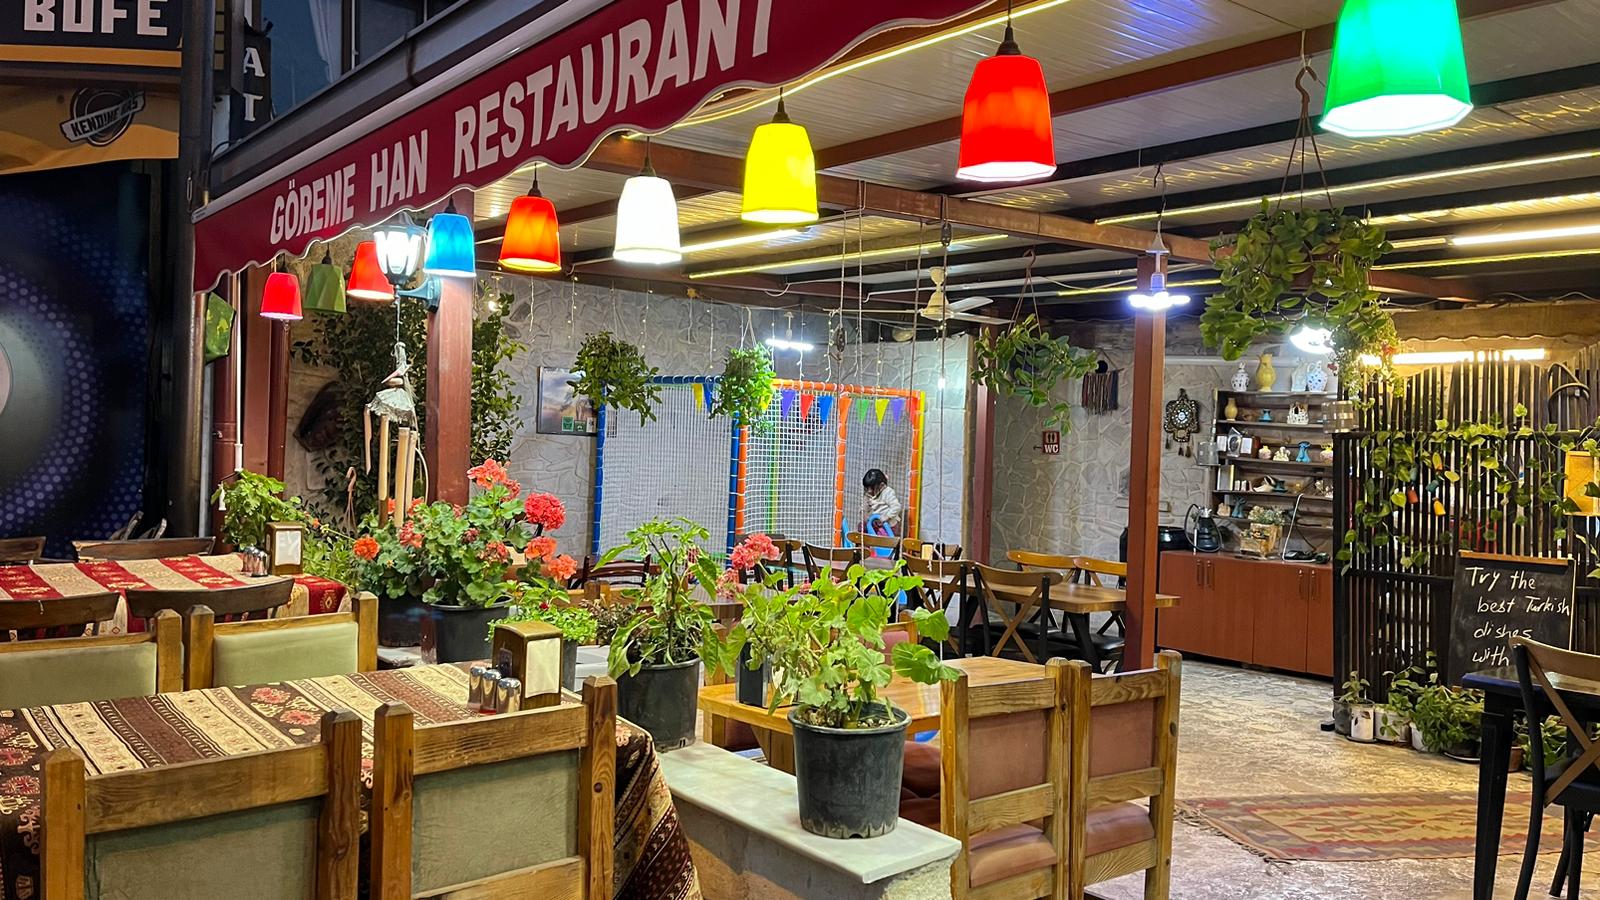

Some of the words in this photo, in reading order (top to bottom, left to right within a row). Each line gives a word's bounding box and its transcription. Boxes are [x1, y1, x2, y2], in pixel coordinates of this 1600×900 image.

[270, 163, 356, 245] GÖREME
[370, 129, 429, 213] HAN
[1044, 444, 1059, 453] WC
[1465, 566, 1501, 592] Try
[1510, 570, 1536, 590] the
[1477, 596, 1516, 613] best
[1525, 595, 1570, 616] Turkish
[1473, 621, 1533, 639] dishes
[1472, 646, 1510, 666] with
